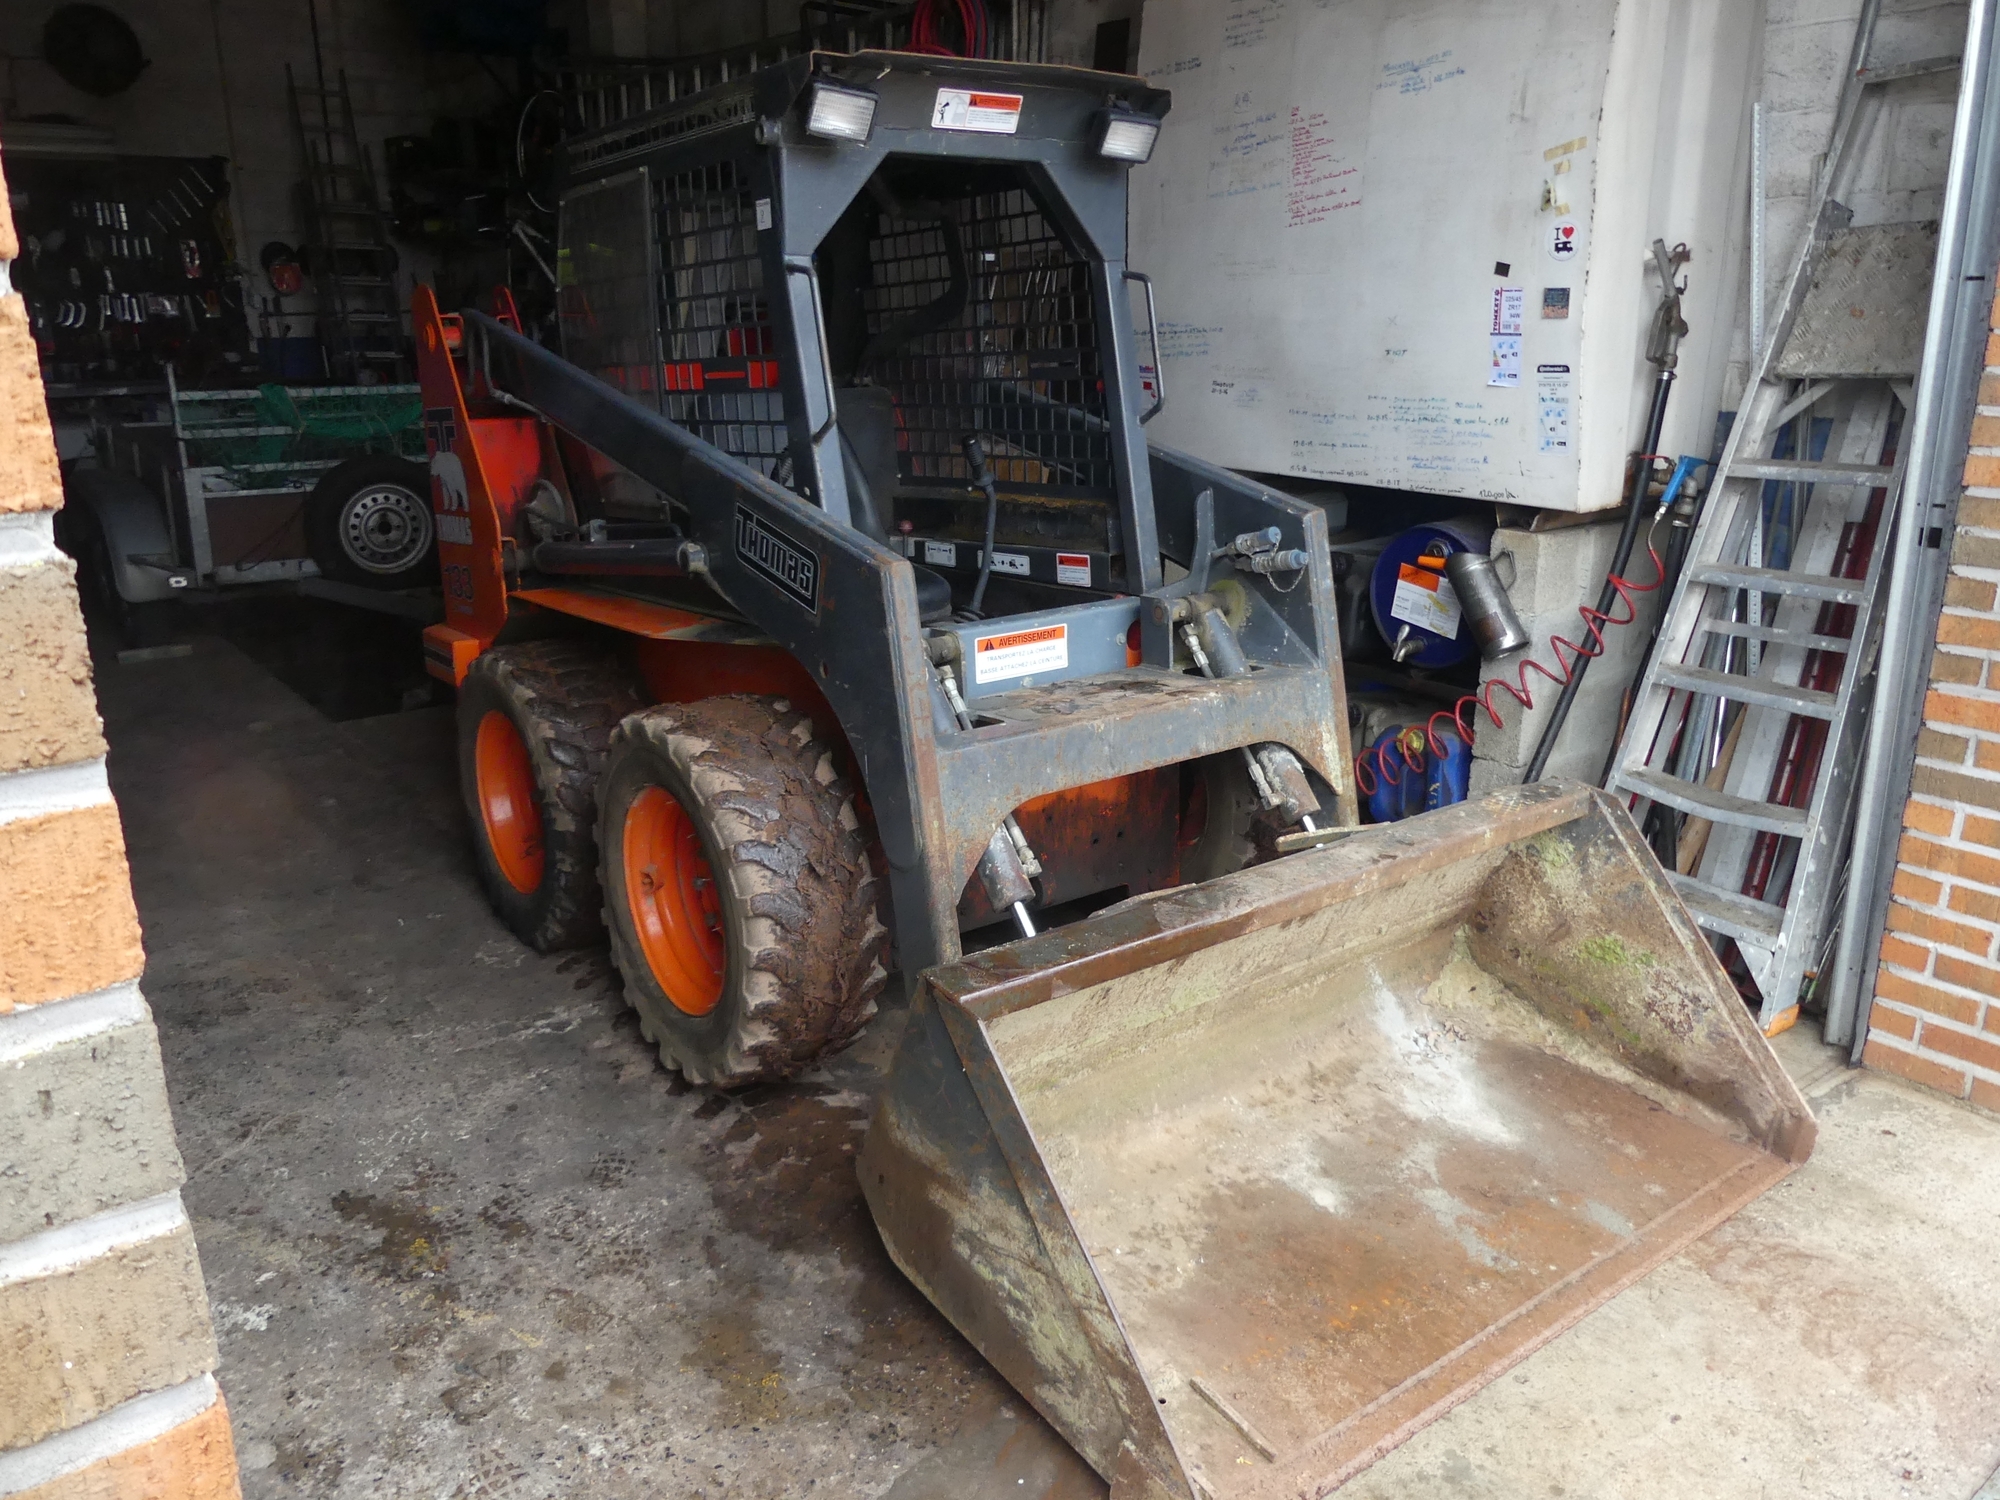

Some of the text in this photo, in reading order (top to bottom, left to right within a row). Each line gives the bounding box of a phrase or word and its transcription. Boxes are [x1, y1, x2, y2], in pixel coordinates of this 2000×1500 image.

[1492, 296, 1500, 333] TOMKET
[998, 629, 1057, 647] AVERTISSEMENT
[987, 650, 1026, 662] TRANSPORTEZ
[1035, 645, 1056, 654] CHARGE
[980, 667, 998, 675] BASSE
[999, 662, 1028, 671] ATTACHEZ
[1037, 655, 1063, 665] CEINTURE
